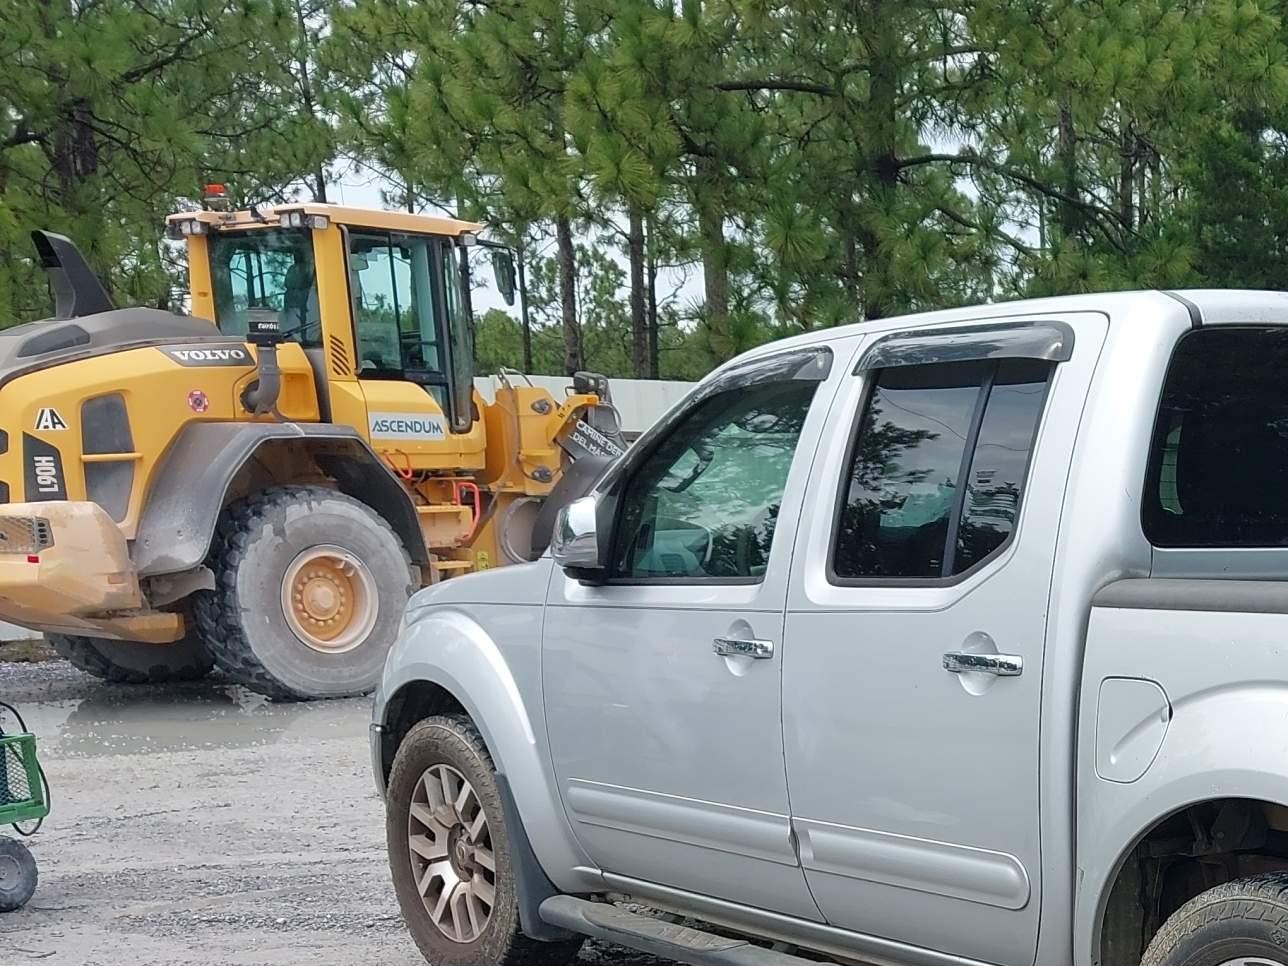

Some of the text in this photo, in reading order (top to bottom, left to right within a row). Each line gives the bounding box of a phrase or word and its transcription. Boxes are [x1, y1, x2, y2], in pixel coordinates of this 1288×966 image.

[171, 349, 245, 361] VOLVO
[372, 420, 444, 434] ASCENDUM
[576, 420, 608, 447] CAMINE
[573, 431, 589, 450] DEL
[33, 456, 58, 492] L90H
